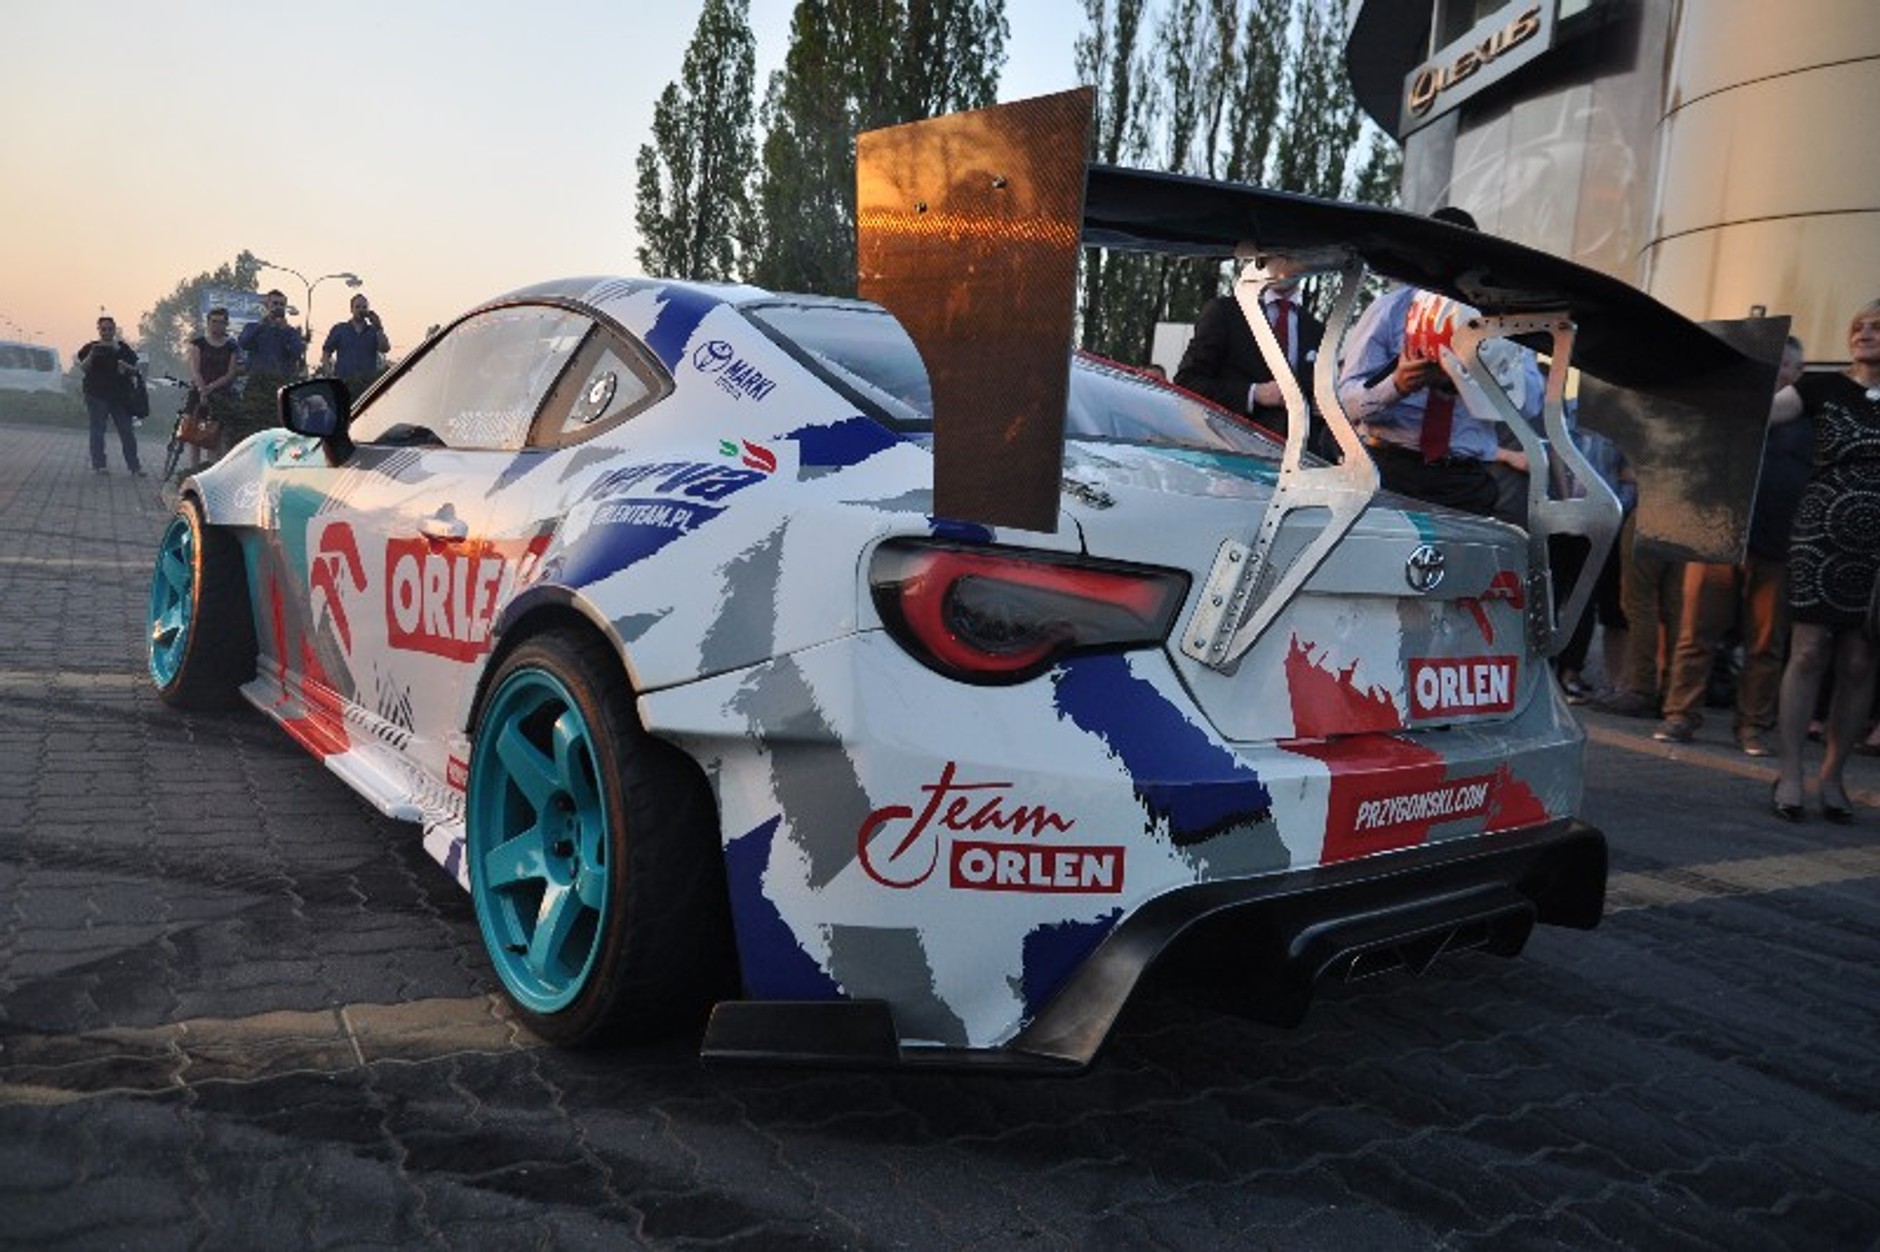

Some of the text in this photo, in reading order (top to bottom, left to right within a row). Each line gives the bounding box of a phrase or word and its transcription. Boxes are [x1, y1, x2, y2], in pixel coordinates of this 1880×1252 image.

[1433, 5, 1541, 92] LEXUS
[724, 359, 777, 402] MARKI
[1415, 664, 1510, 711] ORLEN
[1354, 782, 1489, 831] PRZYGONSKI.COM
[958, 848, 1115, 888] ORLEN
